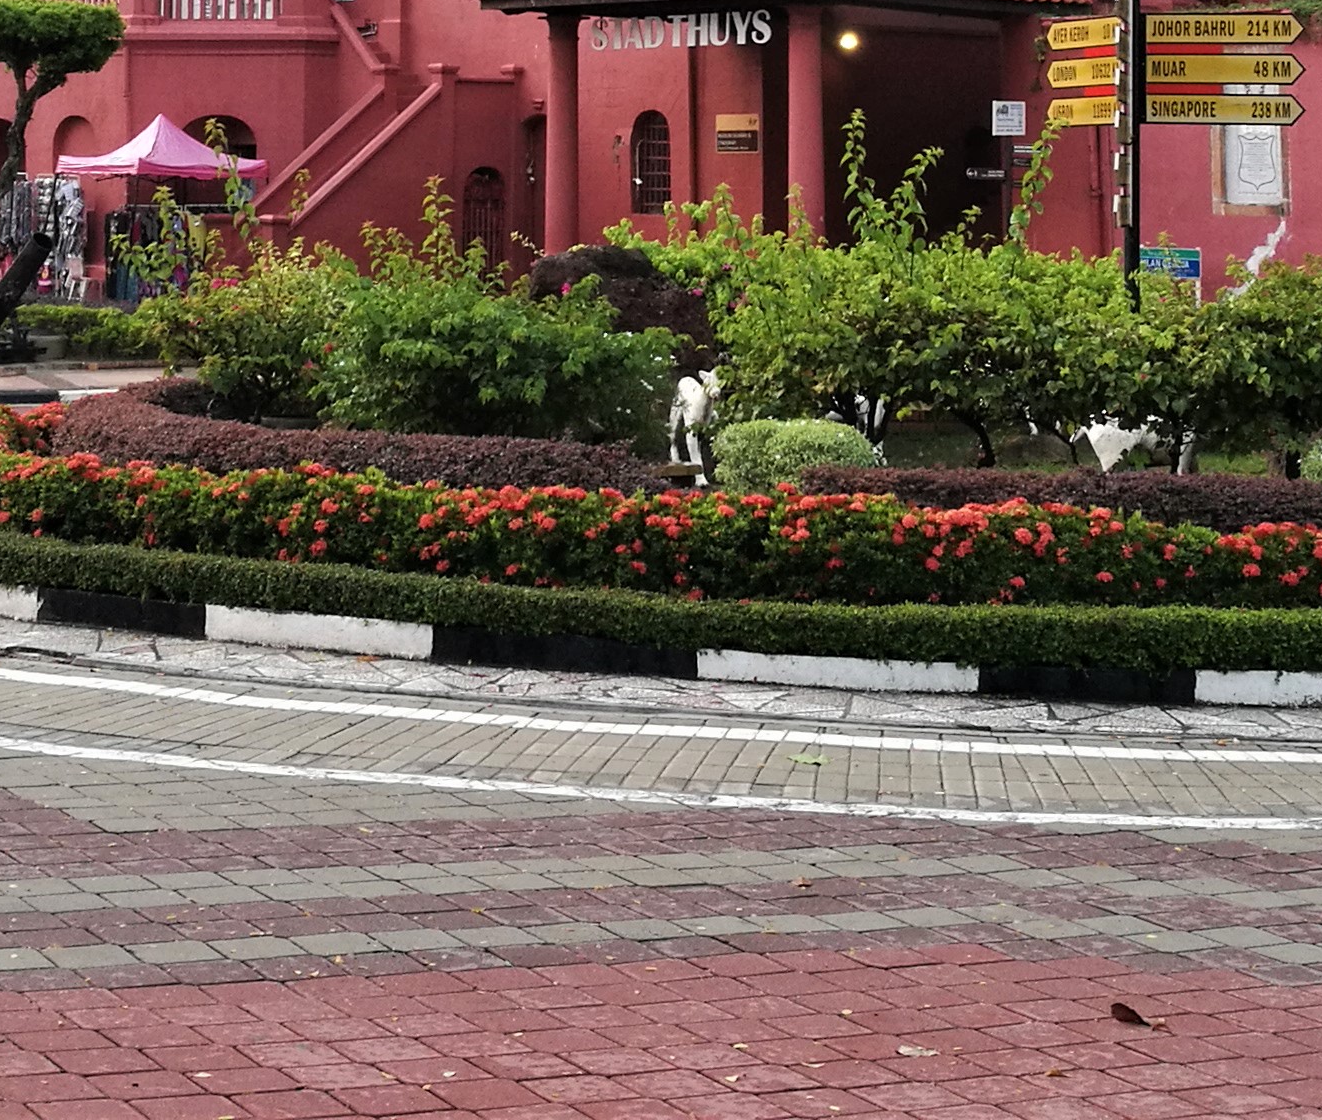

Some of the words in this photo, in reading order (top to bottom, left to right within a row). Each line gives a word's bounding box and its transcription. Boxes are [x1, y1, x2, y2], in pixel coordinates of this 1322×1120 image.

[591, 9, 772, 51] STADTHUYS
[1054, 28, 1067, 43] AYER
[1069, 26, 1089, 41] KEROH
[1151, 20, 1190, 37] JOHOR
[1195, 20, 1235, 36] BAHRU
[1247, 20, 1269, 36] 214
[1273, 20, 1291, 36] KM
[1053, 66, 1076, 82] LONDON
[1151, 61, 1186, 77] MUAR
[1254, 61, 1269, 77] 48
[1273, 61, 1291, 77] KM
[1151, 101, 1216, 117] SINGAPORE
[1251, 102, 1271, 118] 238
[1275, 102, 1291, 118] KM
